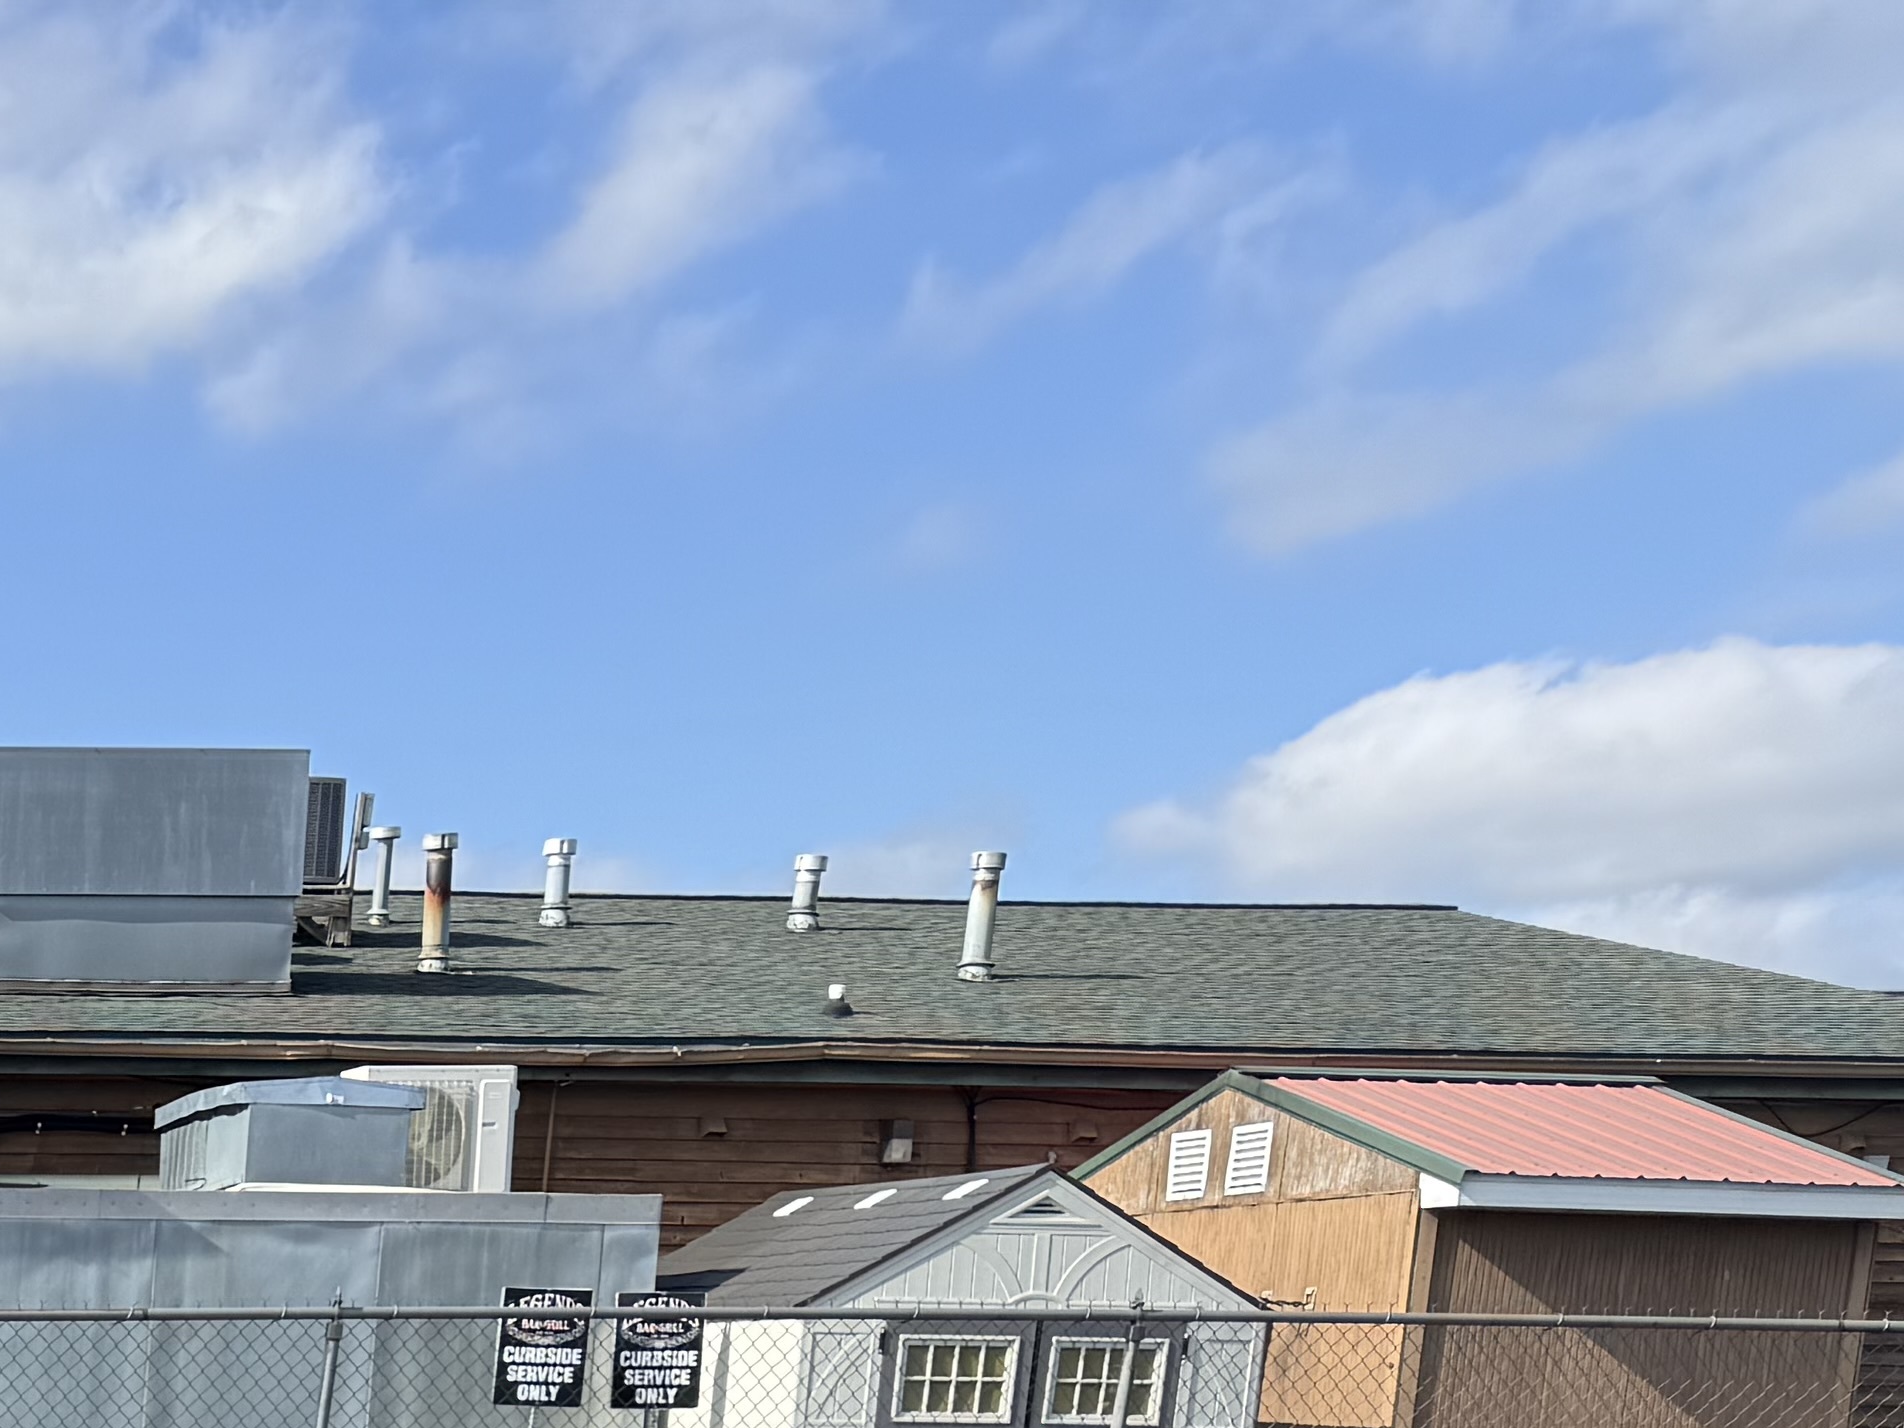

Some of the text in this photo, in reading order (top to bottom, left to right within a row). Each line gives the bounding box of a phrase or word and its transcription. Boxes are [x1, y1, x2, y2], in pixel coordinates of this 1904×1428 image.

[503, 1346, 583, 1365] CURBSIDE
[620, 1350, 699, 1367] CURBSIDE
[506, 1365, 575, 1384] SERVICE
[624, 1368, 692, 1386] SERVICE
[516, 1384, 560, 1402] ONLY
[635, 1387, 678, 1404] ONLY
